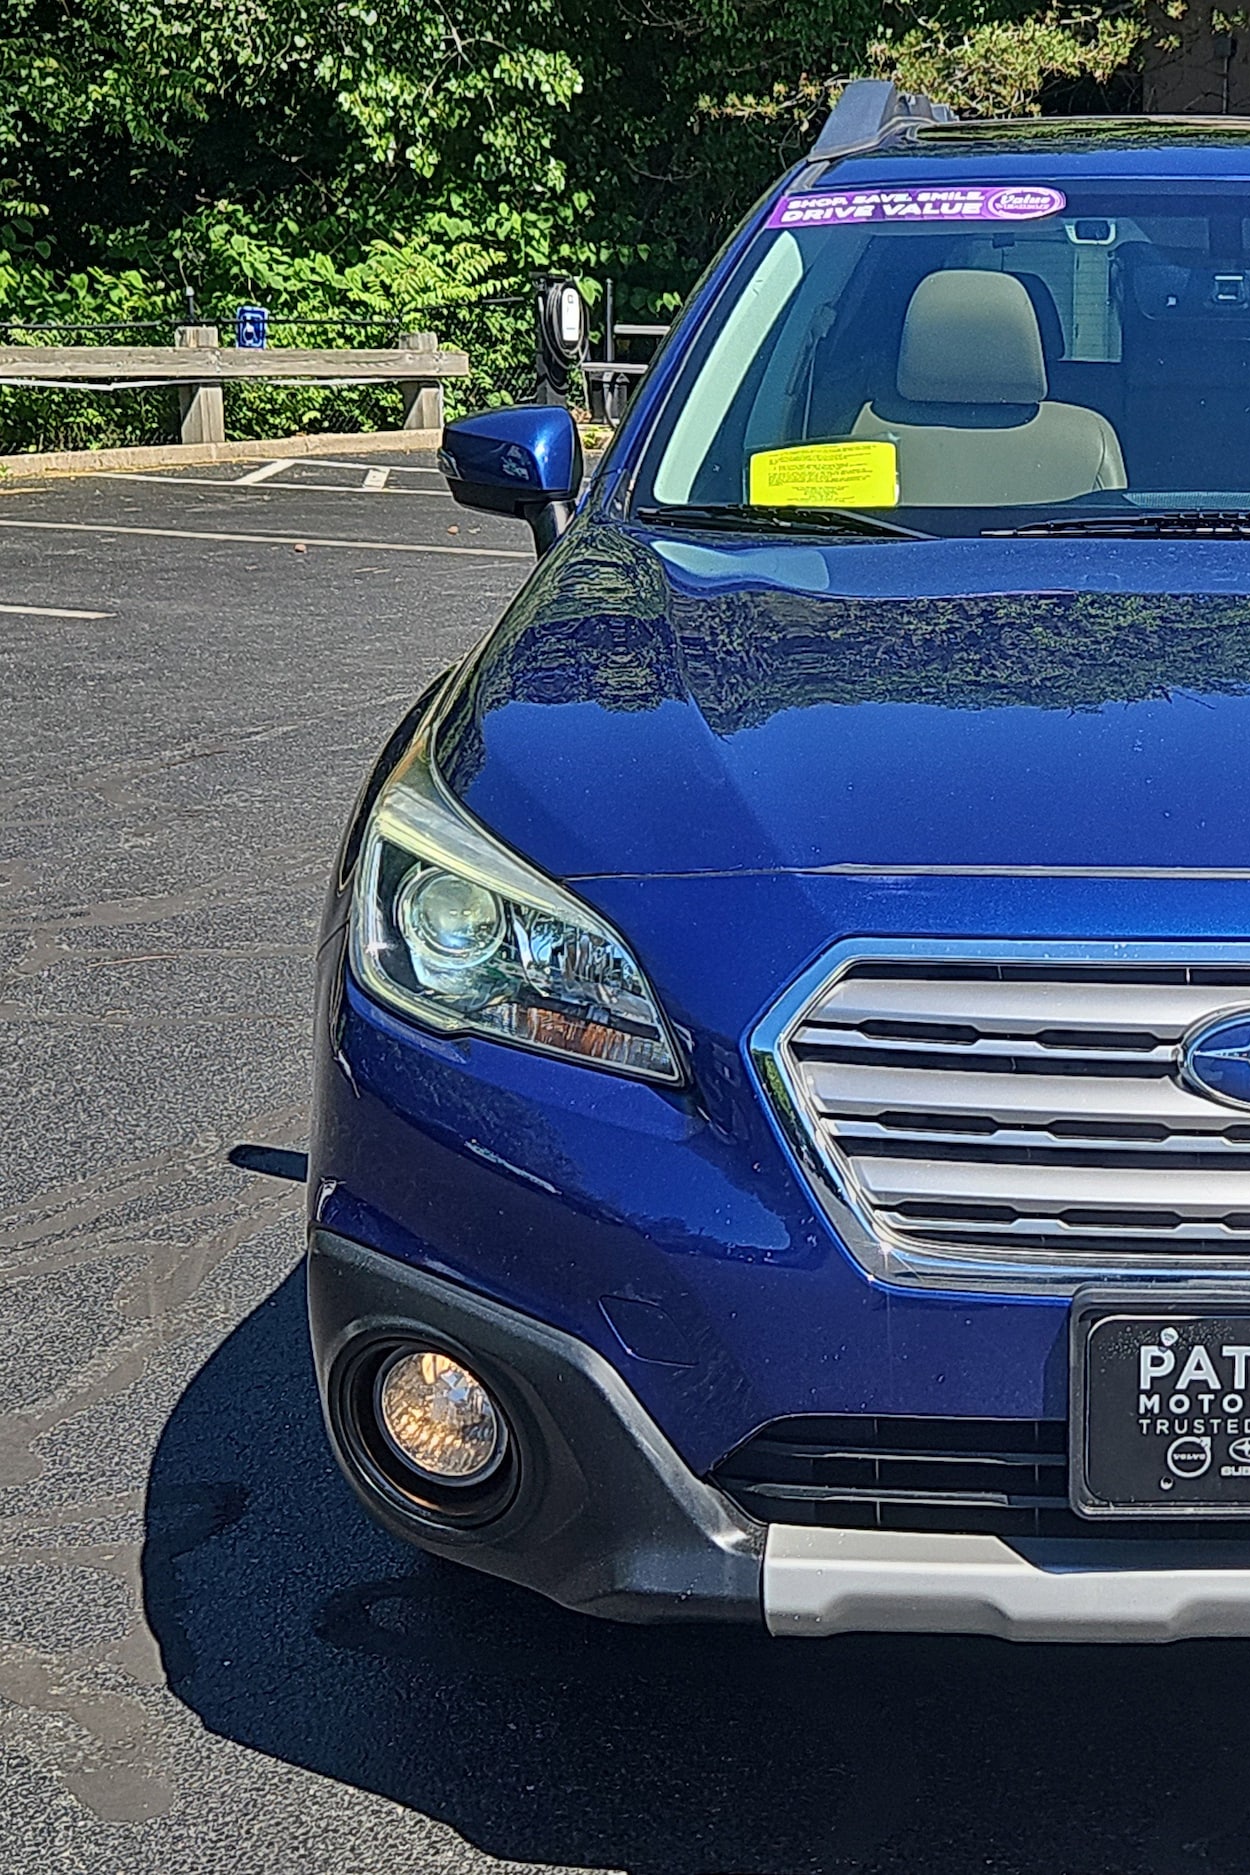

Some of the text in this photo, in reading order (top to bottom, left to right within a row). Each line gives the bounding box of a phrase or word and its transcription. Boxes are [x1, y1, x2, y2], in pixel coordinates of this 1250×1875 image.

[780, 205, 875, 223] DRIVE
[882, 202, 983, 216] VALUE
[1172, 1453, 1207, 1461] VOLVO
